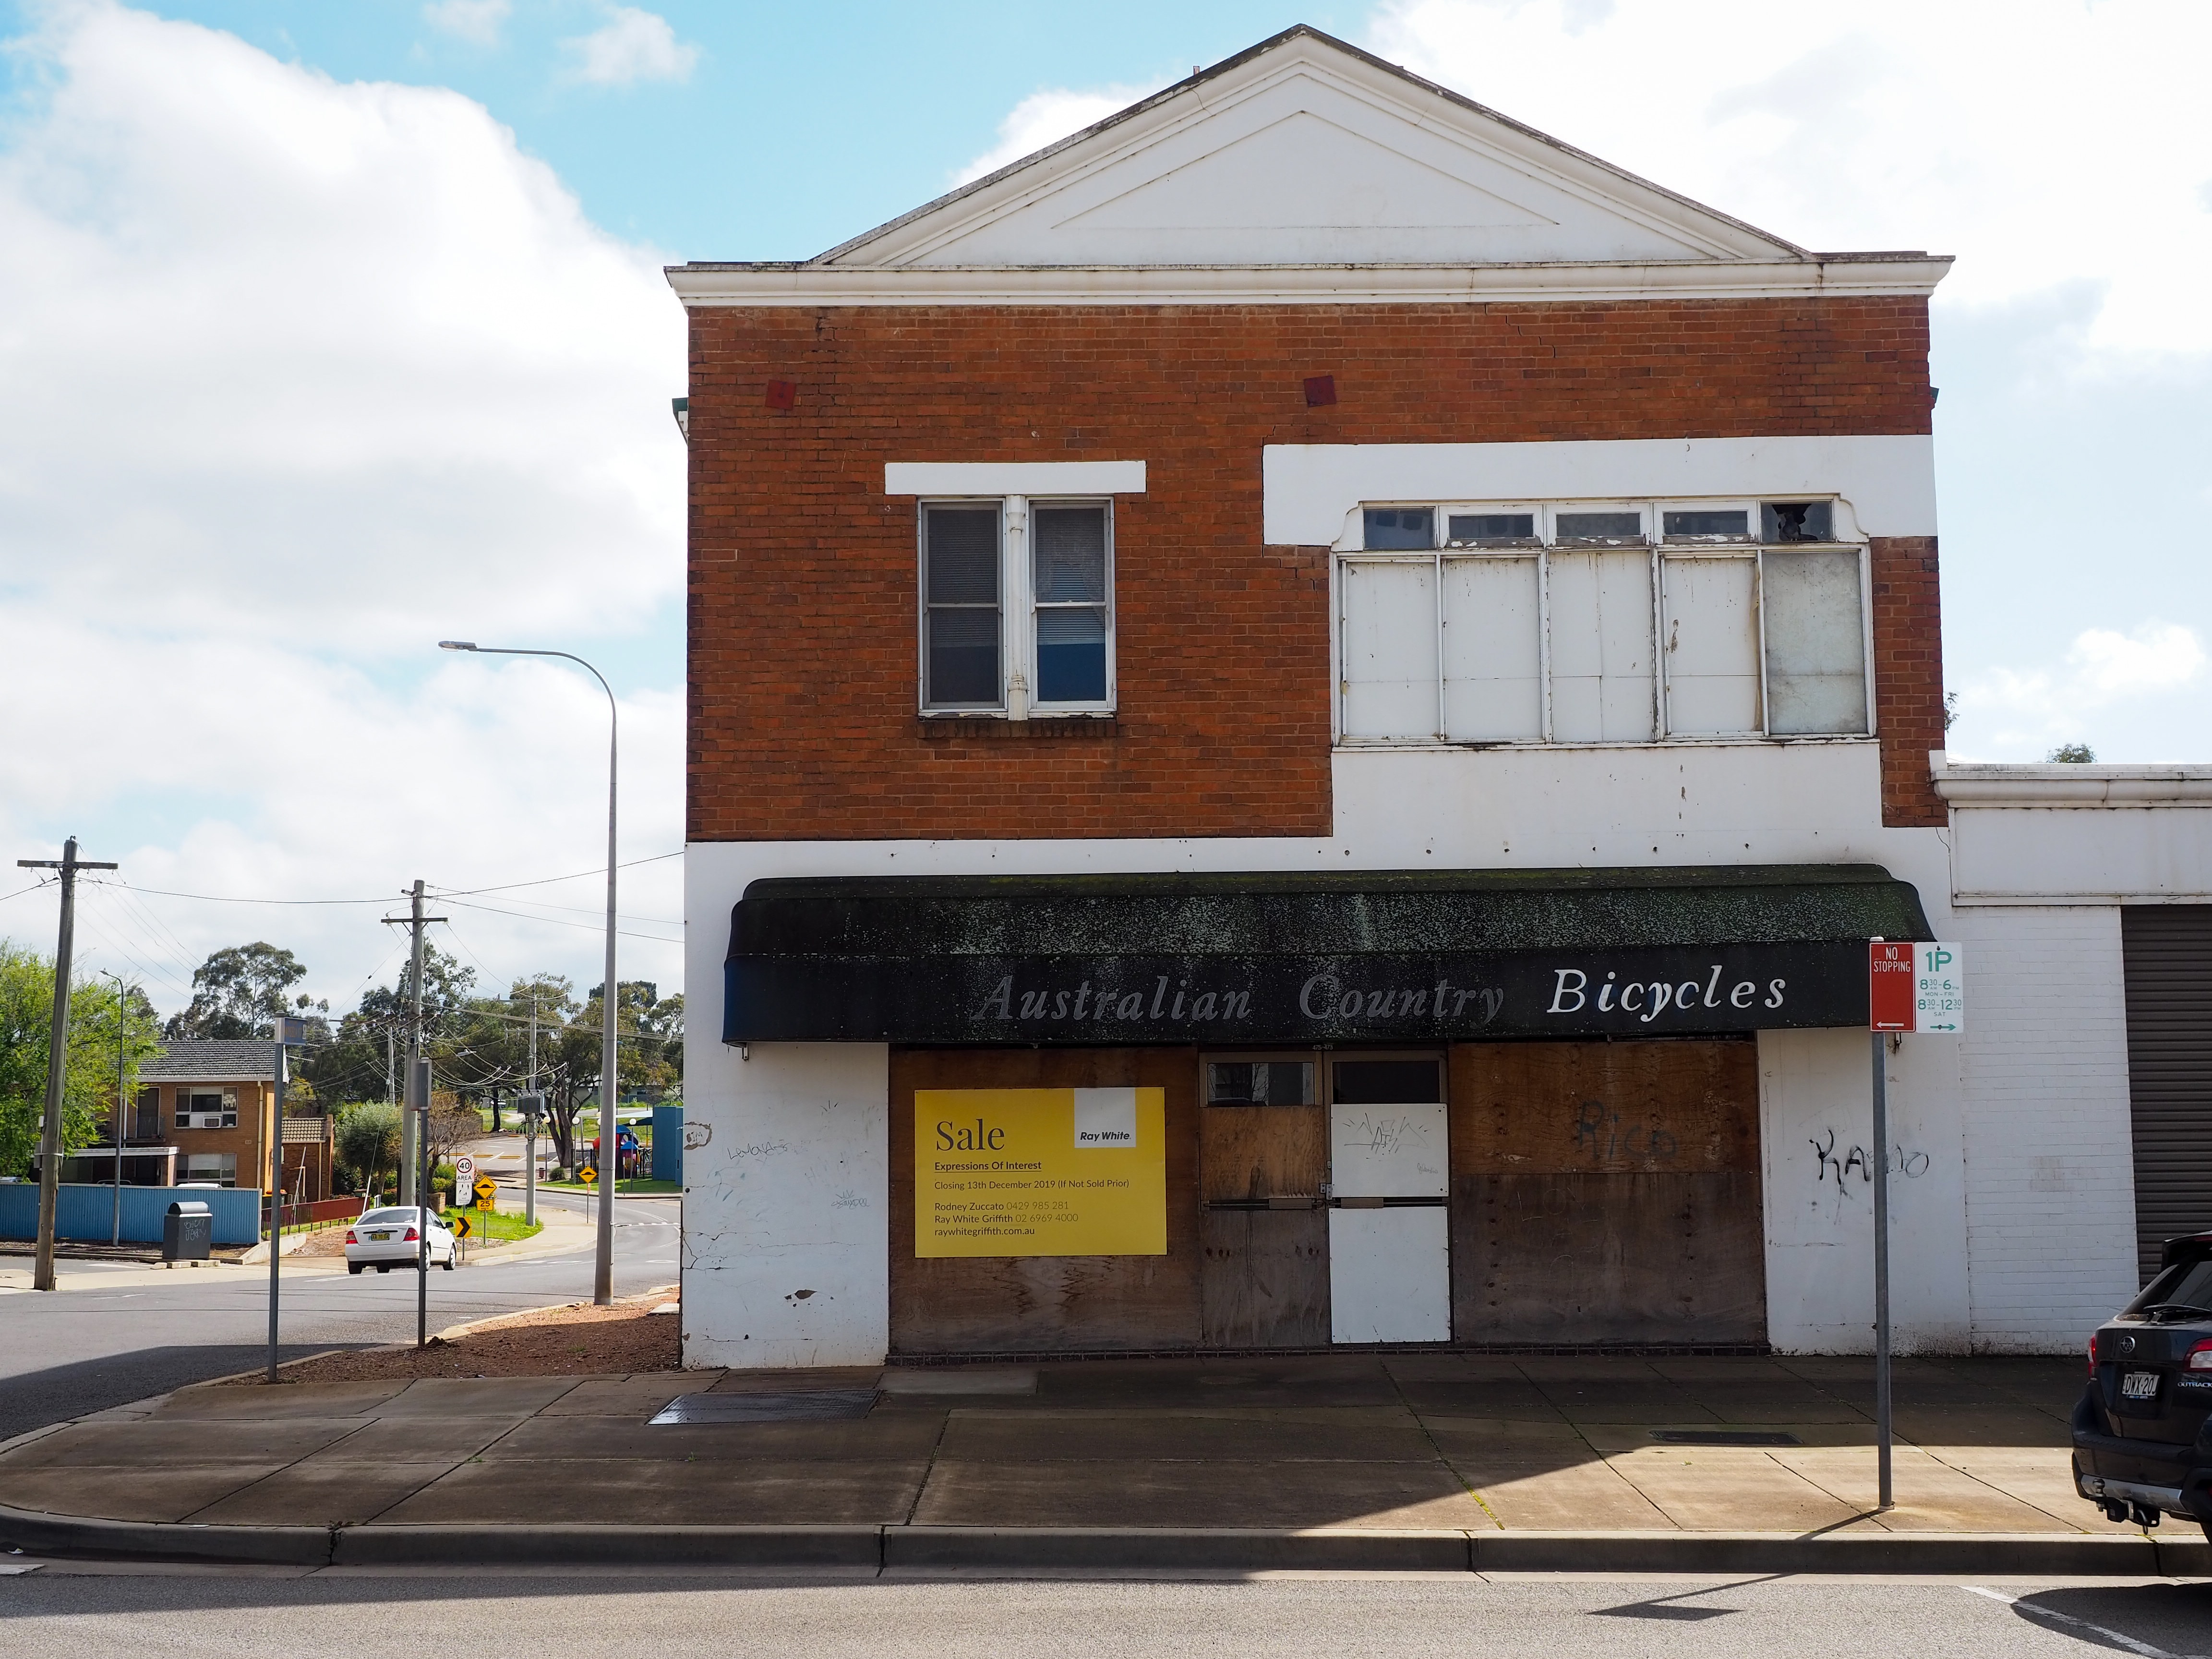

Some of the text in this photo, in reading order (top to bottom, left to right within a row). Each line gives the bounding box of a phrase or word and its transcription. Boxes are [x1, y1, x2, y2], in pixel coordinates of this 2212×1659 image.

[1886, 947, 1898, 960] NO
[1874, 961, 1911, 973] STOPPING
[1925, 951, 1952, 972] 1P
[971, 965, 1786, 1028] Australian Country Bicycles
[936, 1118, 1005, 1151] Sale
[1080, 1131, 1130, 1142] Ray White
[935, 1161, 1042, 1171] Expressions Of Interest
[935, 1179, 1130, 1190] Closing 13th December 2019 (If Not Sold Prior)
[935, 1201, 1069, 1212] Rodney Zuccato 0429 985 281
[935, 1213, 1079, 1225] Ray White Griffith 02 6969 4000
[935, 1226, 1035, 1238] raywhitegriffith.com.au
